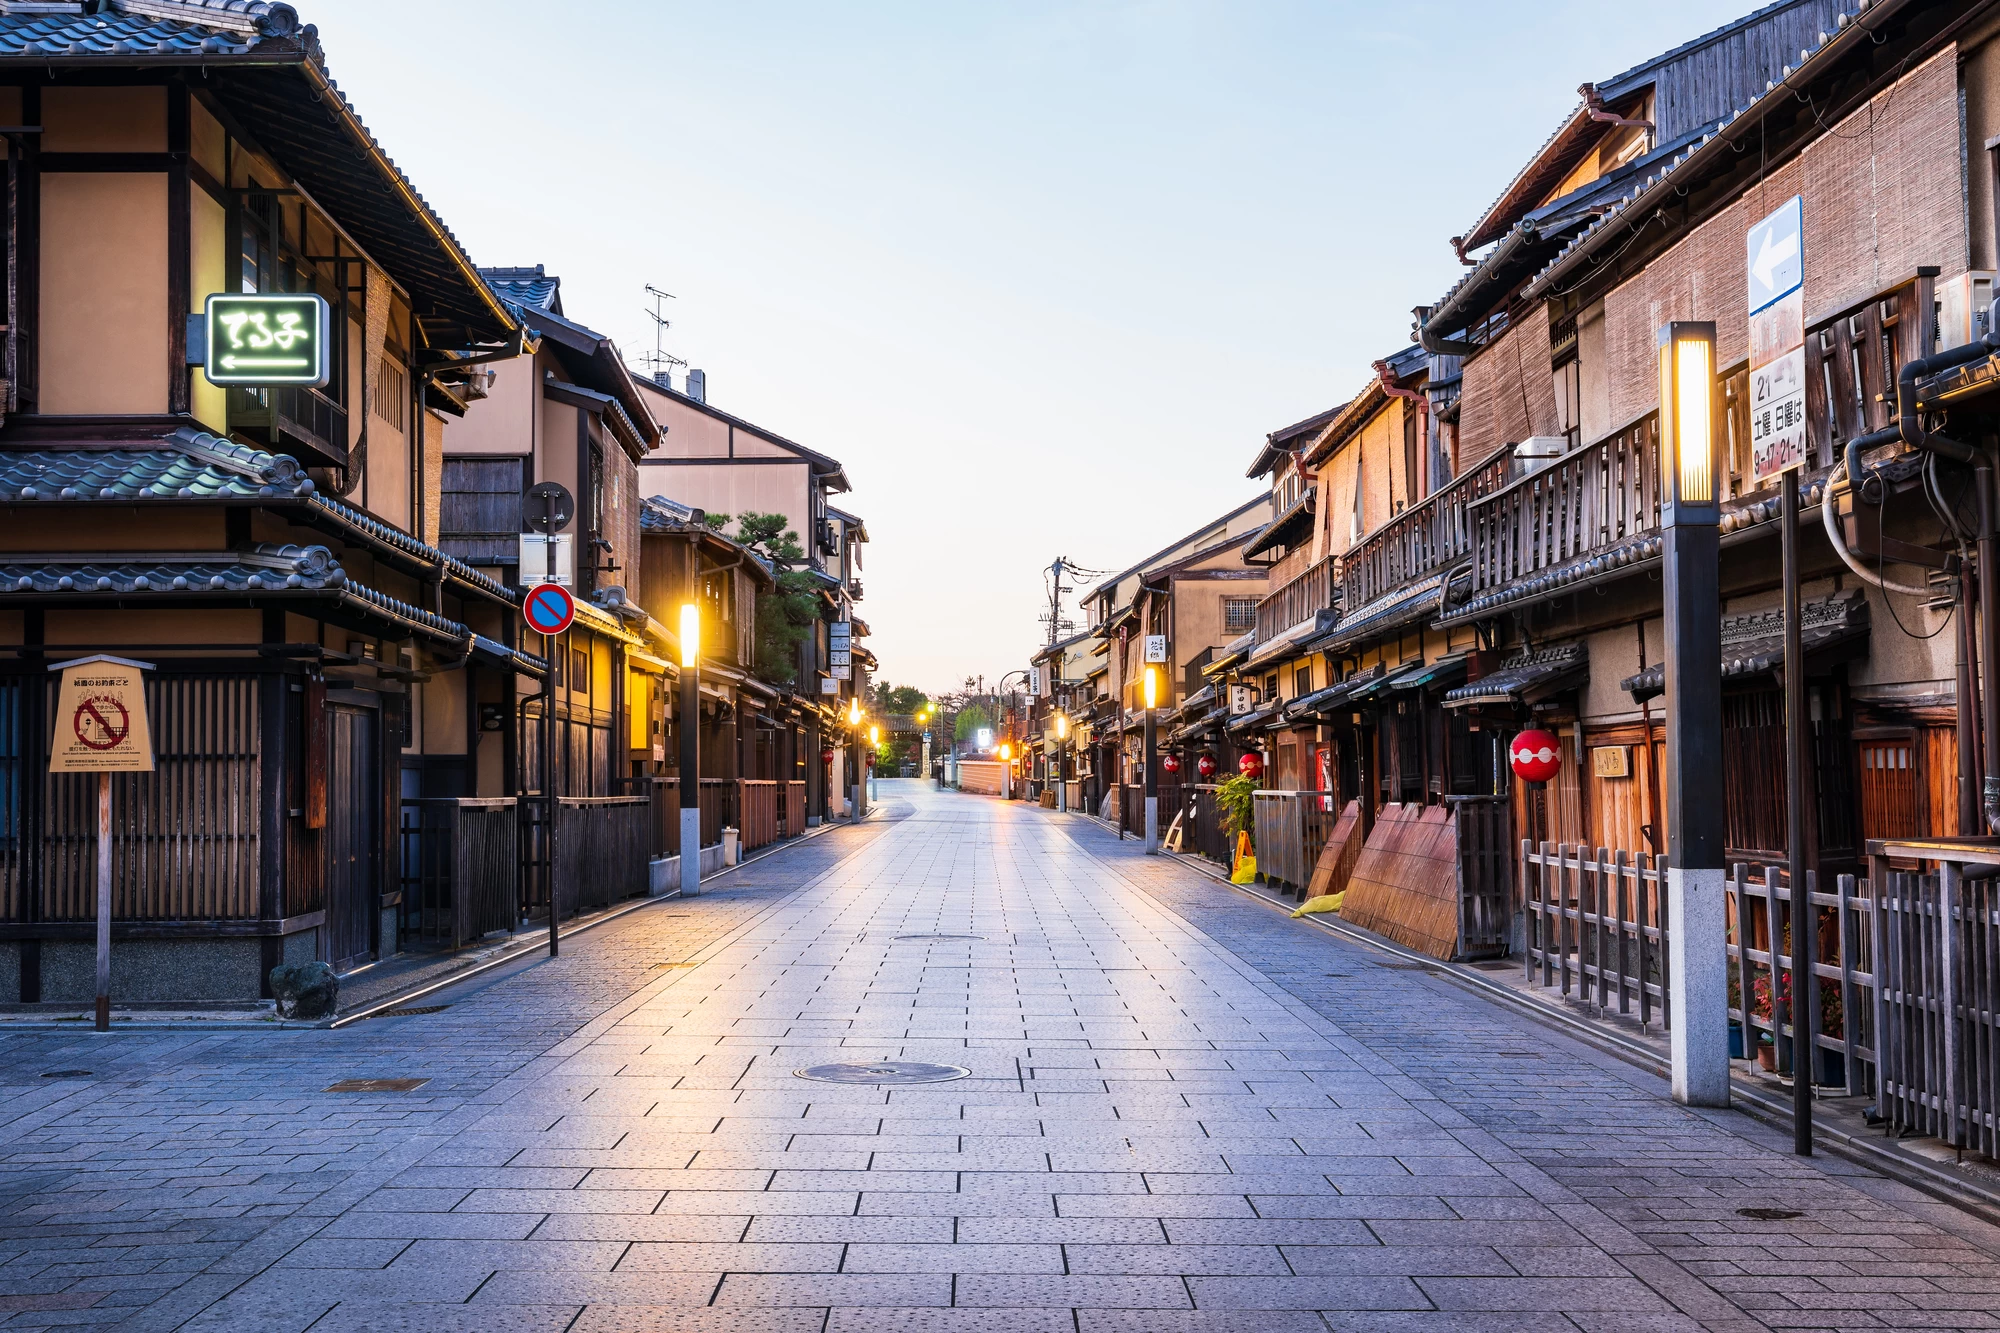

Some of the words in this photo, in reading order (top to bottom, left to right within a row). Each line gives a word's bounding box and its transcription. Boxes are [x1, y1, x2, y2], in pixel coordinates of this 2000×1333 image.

[219, 310, 309, 349] てる子
[1754, 397, 1803, 441] 土曜、日曜は
